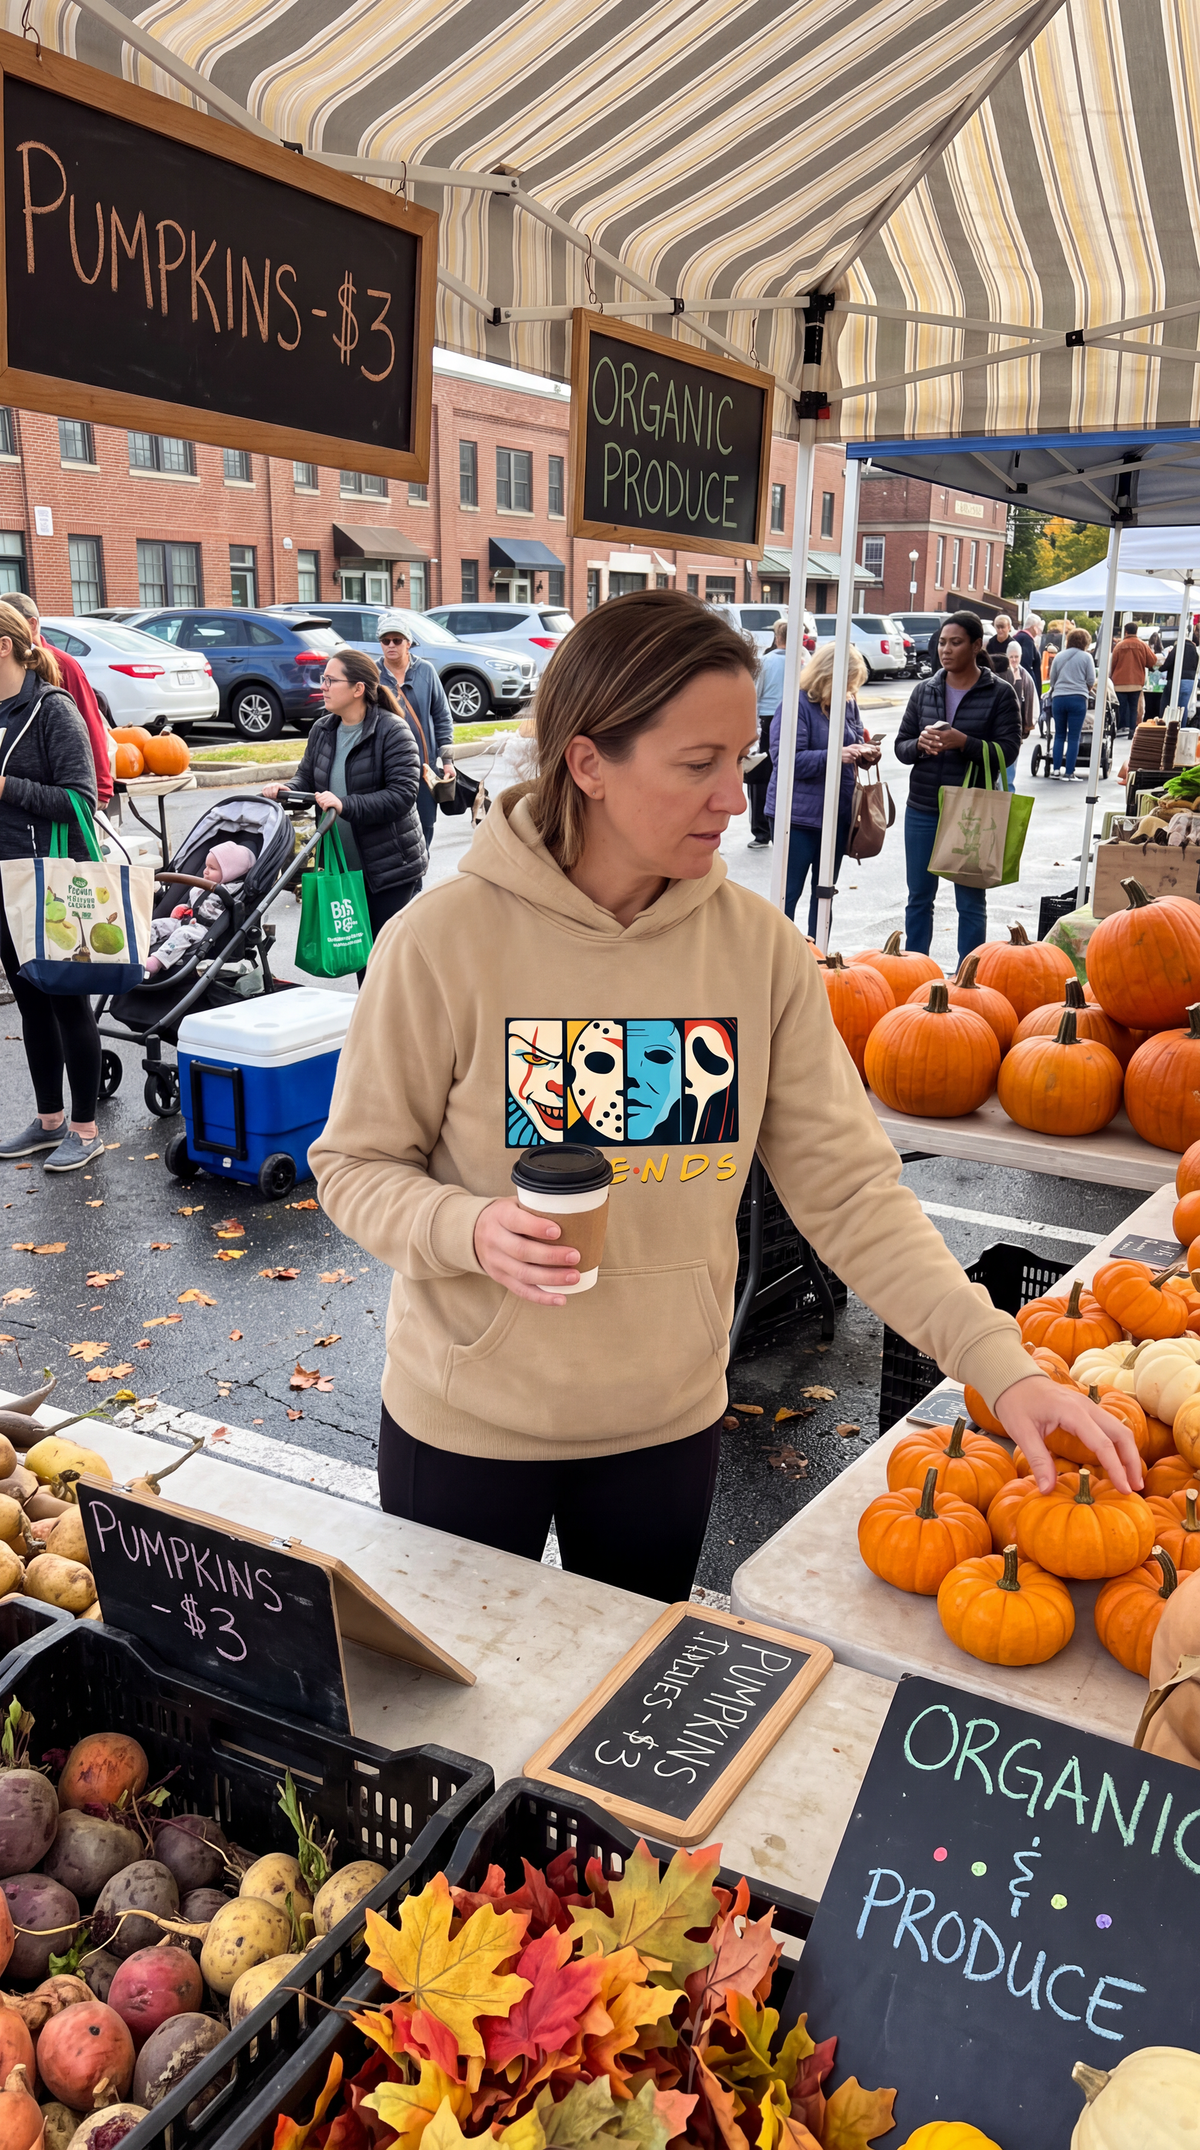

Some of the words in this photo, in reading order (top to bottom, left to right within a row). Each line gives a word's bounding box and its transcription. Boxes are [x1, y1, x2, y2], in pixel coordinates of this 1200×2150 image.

[592, 356, 734, 455] ORGANIC
[603, 442, 739, 528] PRODUCE
[610, 1153, 737, 1184] ENDS
[88, 1500, 283, 1612] PUMPKINS
[654, 1643, 792, 1784] PUMPKINS
[856, 1867, 1147, 2041] PRODUCE
